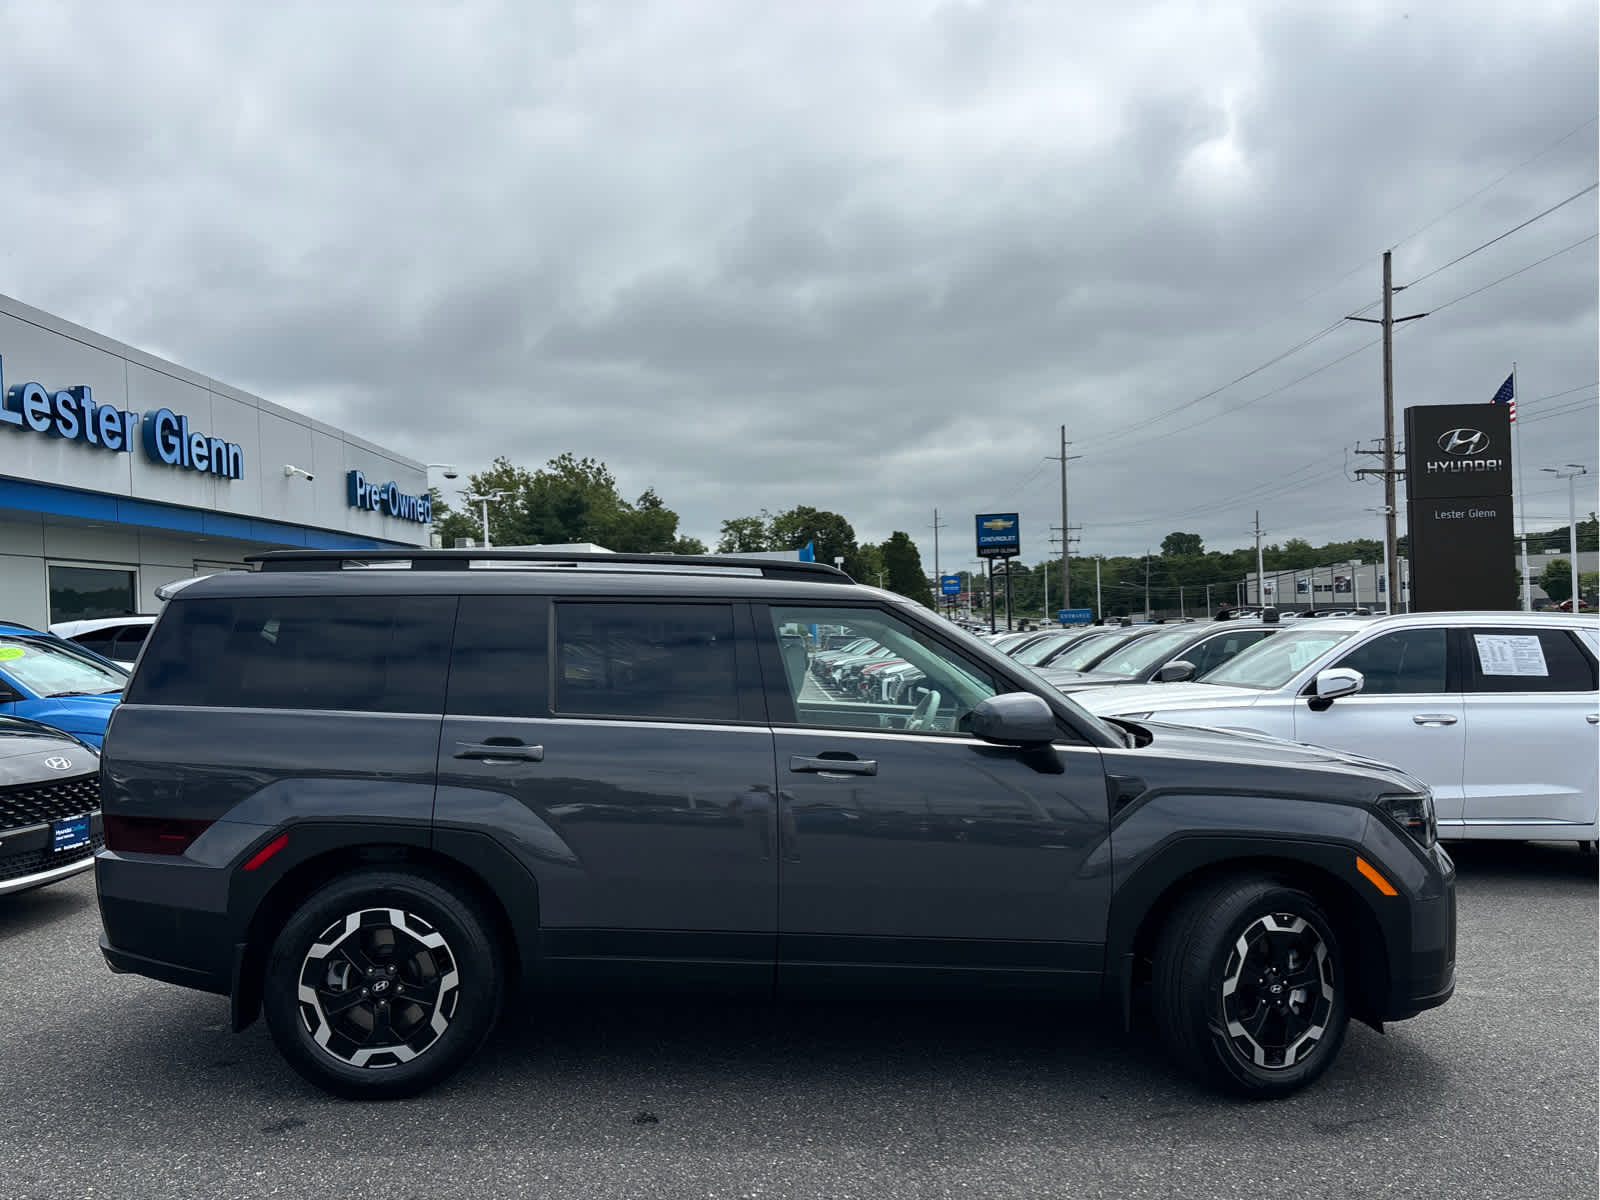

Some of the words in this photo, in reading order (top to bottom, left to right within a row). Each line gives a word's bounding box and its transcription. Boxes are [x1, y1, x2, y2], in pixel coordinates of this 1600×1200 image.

[0, 354, 139, 452] Lester
[144, 407, 243, 480] Glenn
[1426, 459, 1503, 473] HYUNDAI
[348, 470, 432, 523] Pre-Owned
[1434, 509, 1465, 520] Lester
[1468, 508, 1496, 518] Glenn
